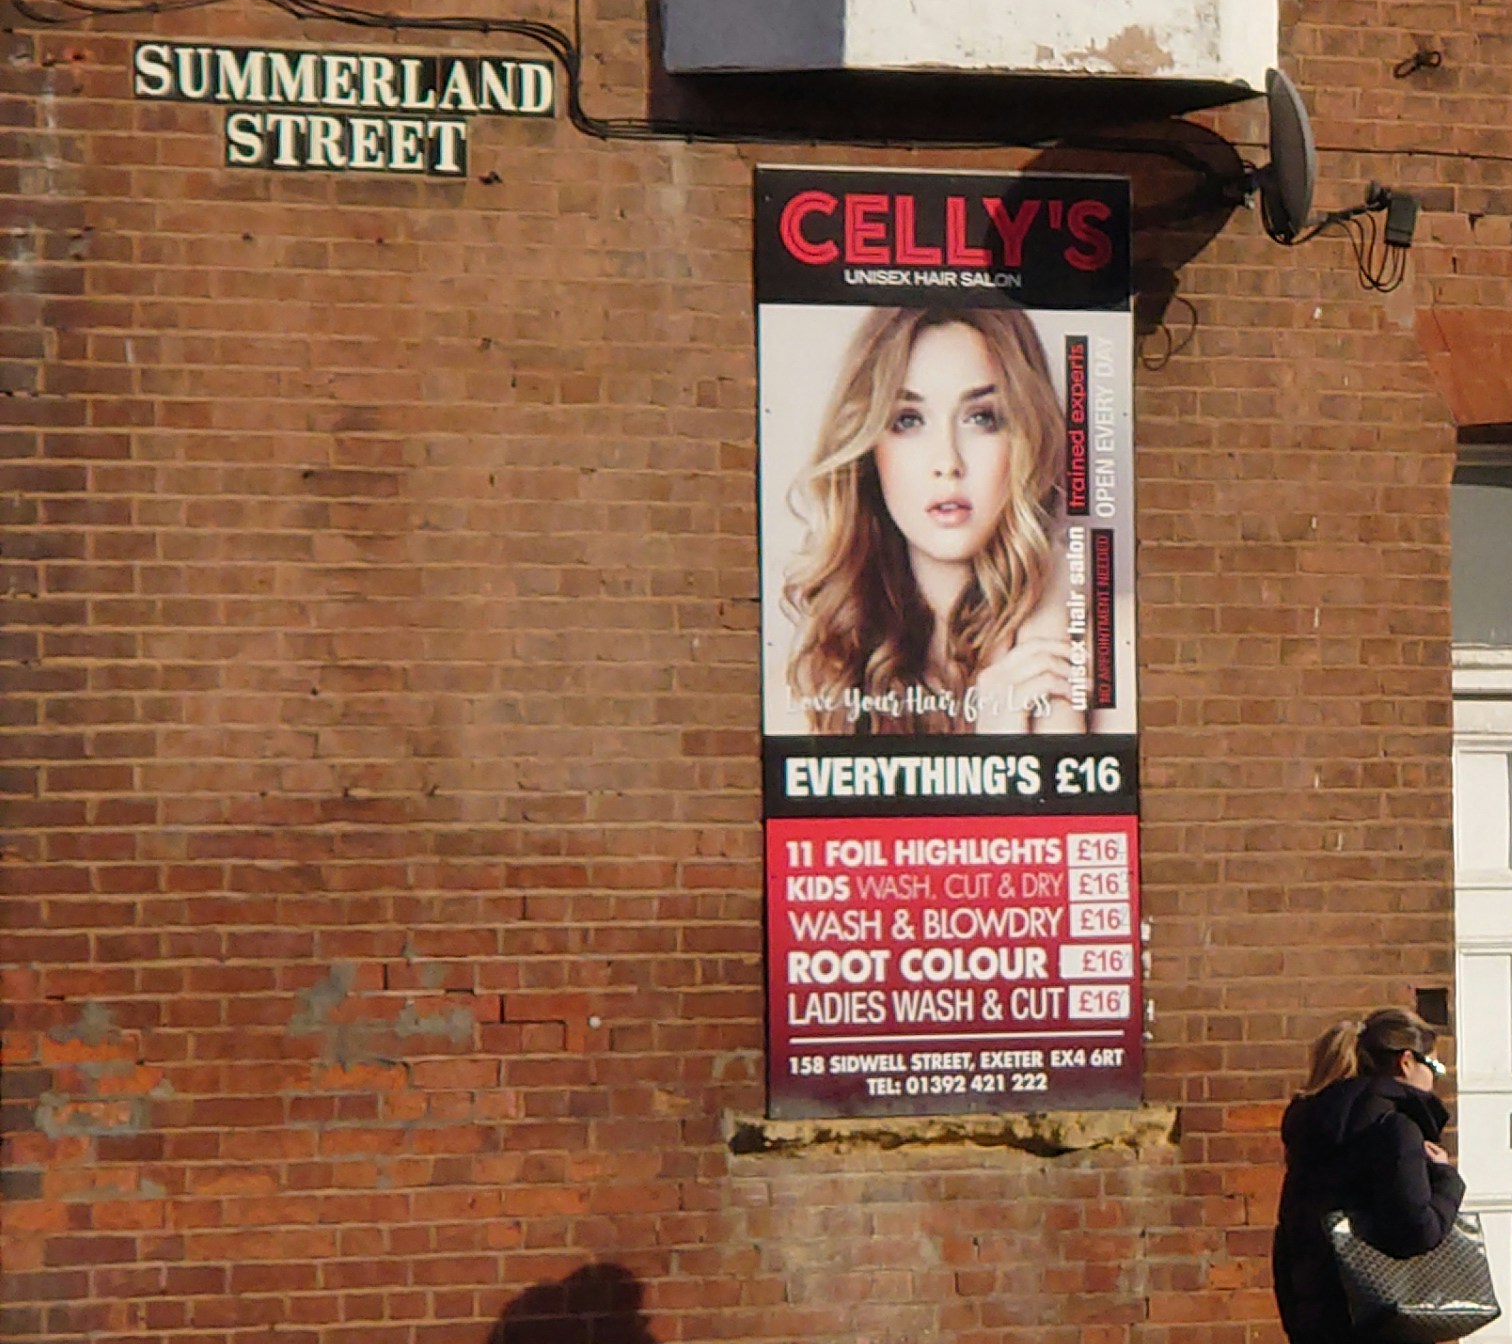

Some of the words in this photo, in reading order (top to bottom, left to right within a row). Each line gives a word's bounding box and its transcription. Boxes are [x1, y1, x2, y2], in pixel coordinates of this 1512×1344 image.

[134, 44, 553, 112] SUMMERLAND
[226, 112, 467, 172] STREET
[780, 190, 1113, 271] CELLY'S
[844, 270, 911, 286] UNISEX
[915, 271, 957, 287] HAIR
[960, 272, 1021, 288] SALON
[1096, 336, 1115, 377] DAY
[1069, 343, 1086, 425] experts
[1096, 384, 1115, 453] EVERY
[1069, 430, 1086, 508] trained
[1096, 457, 1116, 520] OPEN
[1067, 526, 1085, 585] salon
[1096, 536, 1112, 584] NEEDED
[1067, 590, 1086, 634] hair
[1096, 587, 1113, 680] APPOINTMENT
[1070, 641, 1087, 712] unisex
[1098, 683, 1112, 705] NO
[787, 686, 832, 712] Love
[844, 686, 900, 722] Your
[906, 684, 958, 716] Hair
[964, 686, 999, 722] for
[1007, 686, 1051, 717] Less
[786, 756, 1040, 797] EVERYTHING'S
[1055, 756, 1121, 793] £16
[786, 841, 812, 867] 11
[826, 840, 887, 867] FOIL
[895, 838, 1061, 865] HIGHLIGHTS
[1078, 840, 1116, 860] £16
[787, 877, 850, 901] KIDS
[944, 874, 992, 899] CUT
[1001, 874, 1014, 897] &
[1022, 873, 1063, 897] DRY
[1079, 873, 1118, 894] £16
[789, 910, 881, 940] WASH
[891, 910, 915, 940] &
[924, 907, 1064, 939] BLOWDRY
[1081, 909, 1120, 930] £16
[789, 949, 890, 984] ROOT
[901, 946, 1048, 981] COLOUR
[1083, 951, 1122, 971] £16
[788, 991, 885, 1024] LADIES
[894, 989, 972, 1022] WASH
[982, 991, 1002, 1020] &
[1011, 987, 1063, 1019] CUT
[1079, 991, 1120, 1012] £16
[789, 1057, 824, 1074] 158
[829, 1055, 906, 1073] SIDWELL
[911, 1052, 974, 1071] STREET,
[980, 1051, 1043, 1069] EXETER
[1050, 1050, 1085, 1067] EX4
[1091, 1049, 1124, 1066] 6RT
[868, 1077, 901, 1095] TEL:
[907, 1075, 966, 1094] 01392
[970, 1074, 1005, 1092] 421
[1011, 1073, 1048, 1090] 222
